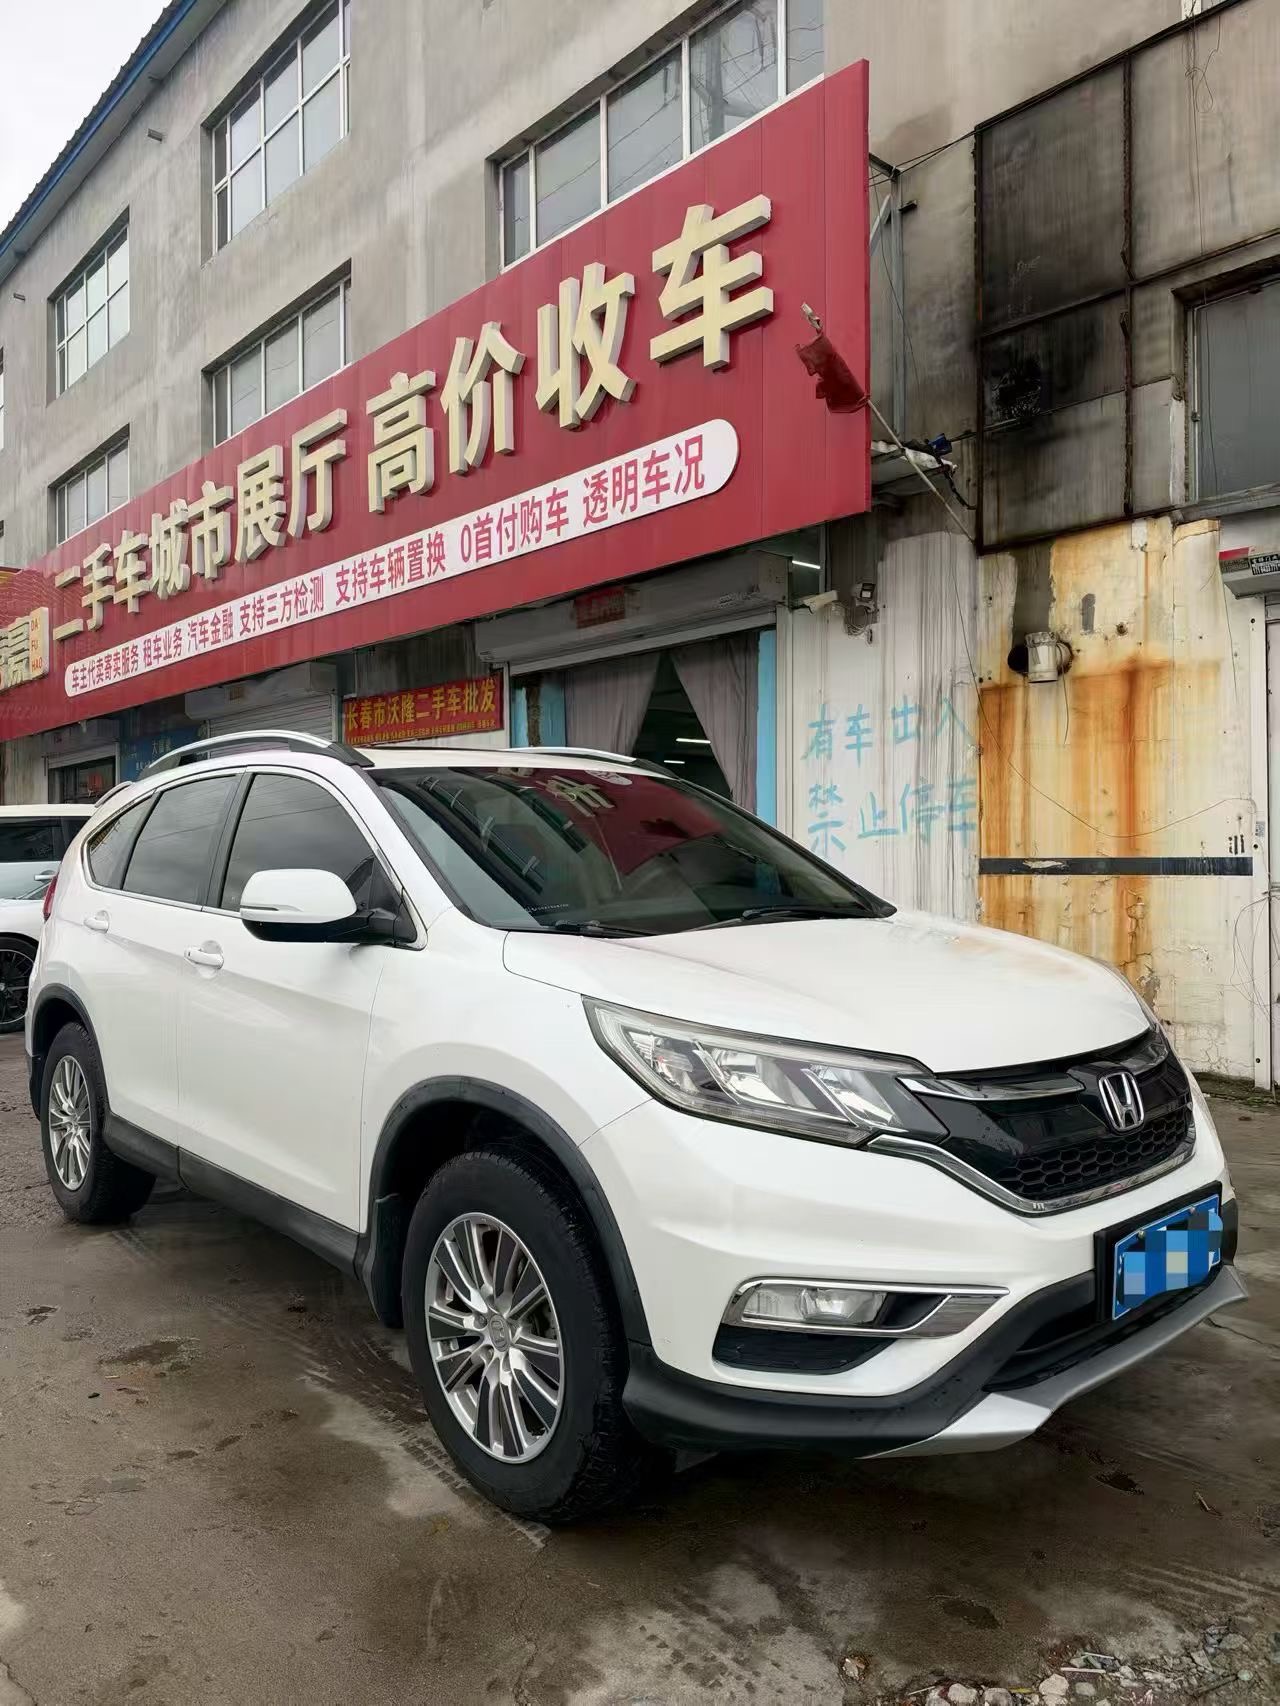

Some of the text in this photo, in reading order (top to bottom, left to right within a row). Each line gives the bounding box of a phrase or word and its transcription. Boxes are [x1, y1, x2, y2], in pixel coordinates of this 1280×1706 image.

[53, 194, 774, 641] 二手车城市展厅 高价收车
[71, 434, 705, 692] 车主代卖寄卖服务 租车业务 汽车金融 支持三方检测 支持车辆置换 0首付购车 透明车况
[346, 678, 496, 731] 长春市沃隆二手车批发
[801, 693, 976, 768] 有车出入
[808, 777, 977, 855] 禁止停车
